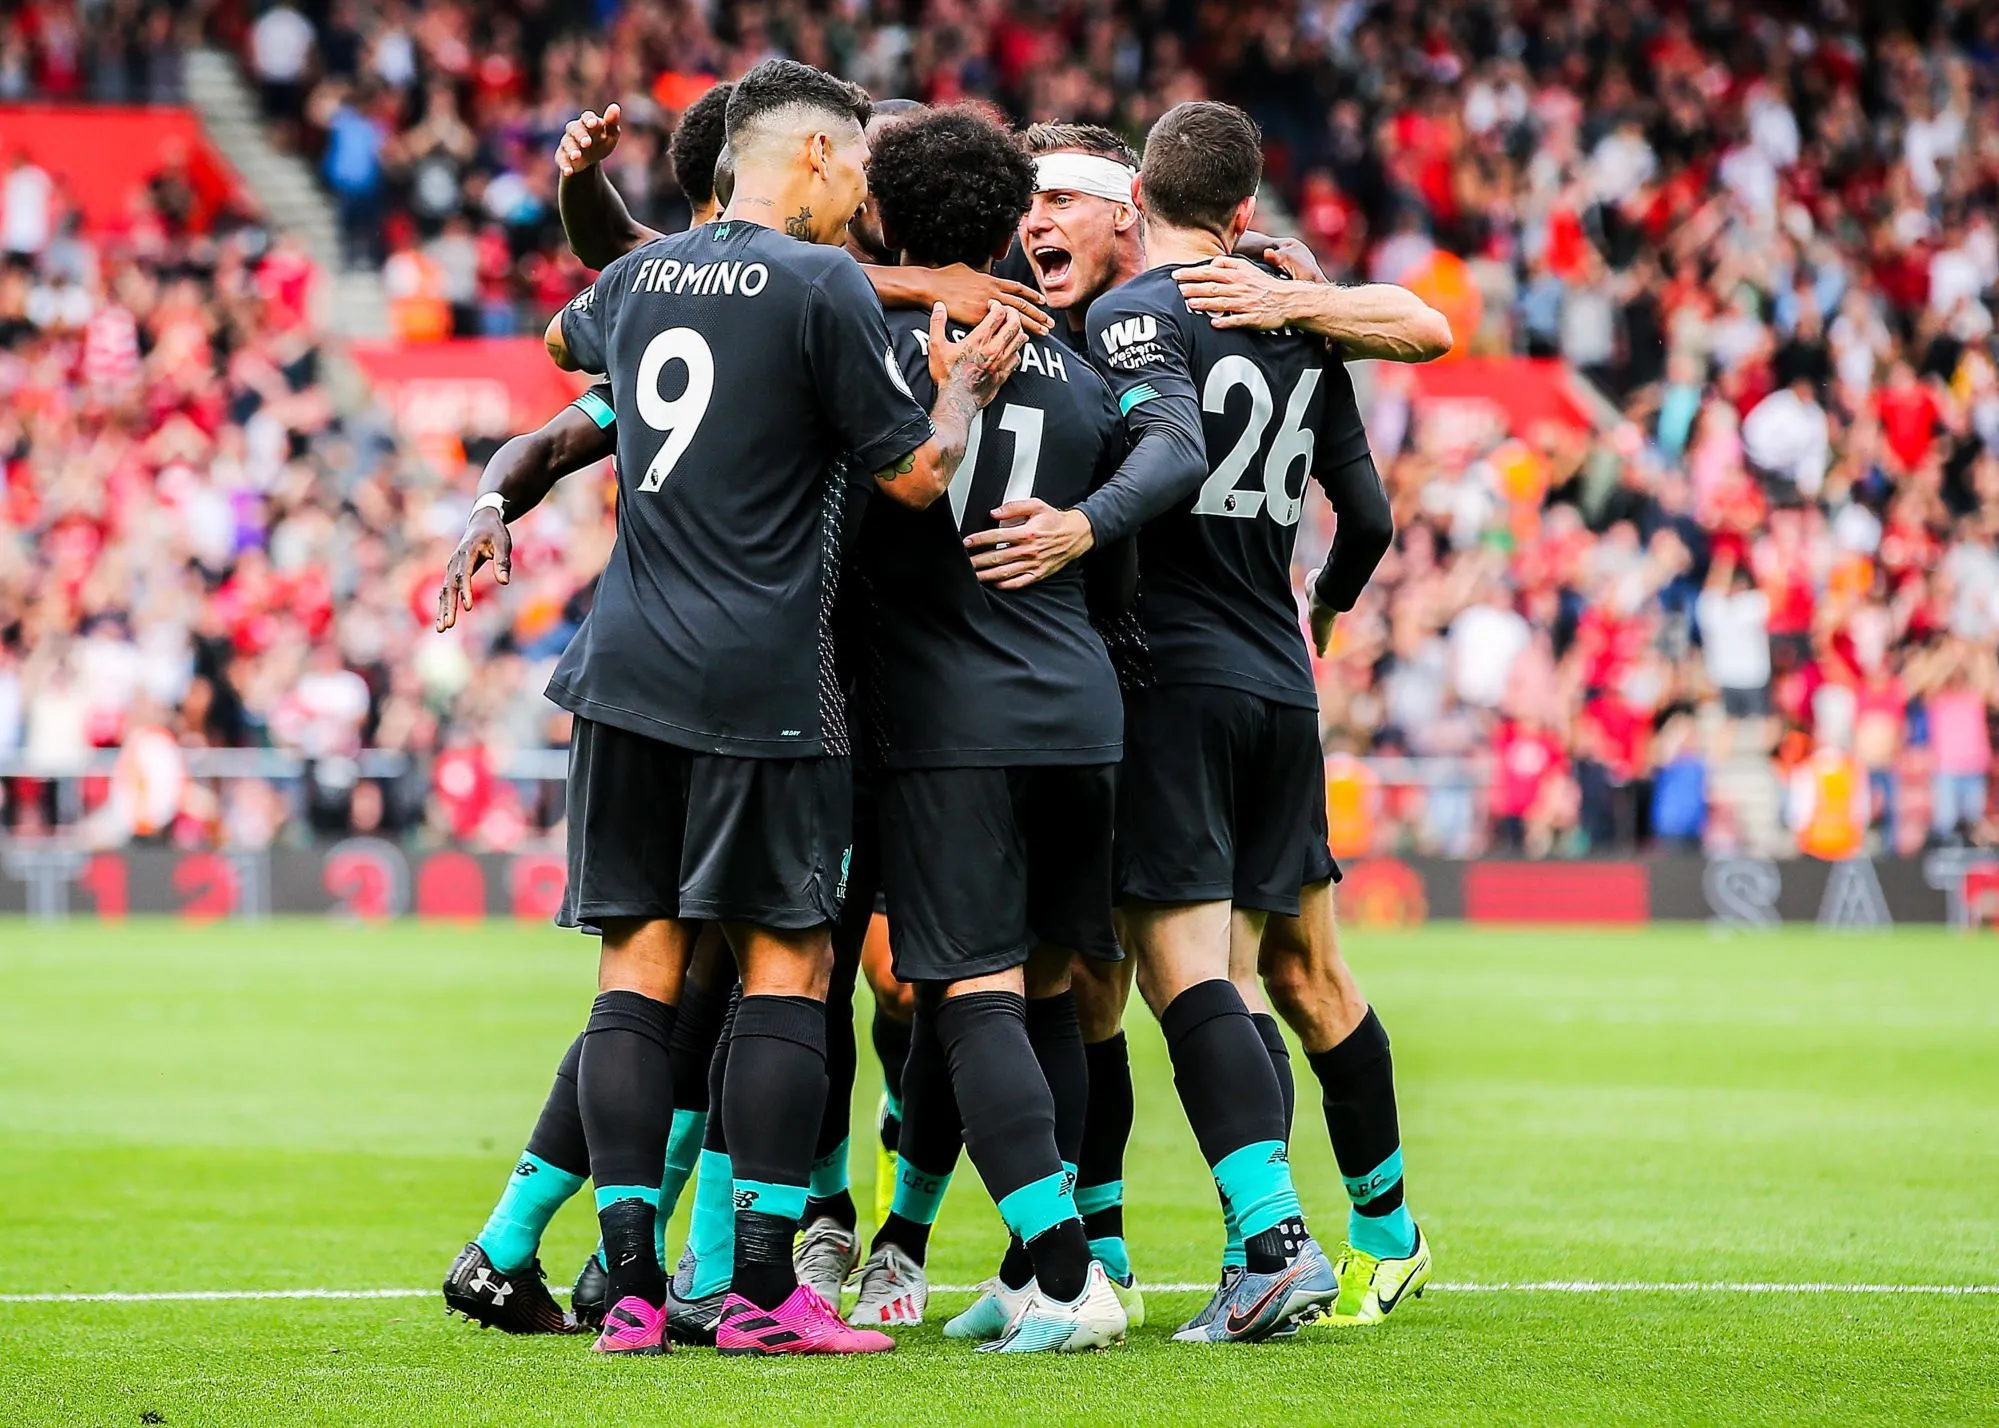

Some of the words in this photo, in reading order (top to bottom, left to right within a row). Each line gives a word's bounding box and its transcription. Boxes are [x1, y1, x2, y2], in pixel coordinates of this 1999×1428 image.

[631, 259, 769, 298] FIRMINO
[1100, 315, 1157, 354] WU
[1108, 342, 1161, 368] Western
[1123, 353, 1165, 369] Union
[635, 326, 715, 493] 9
[1191, 355, 1323, 527] 26
[902, 1169, 938, 1194] LFC
